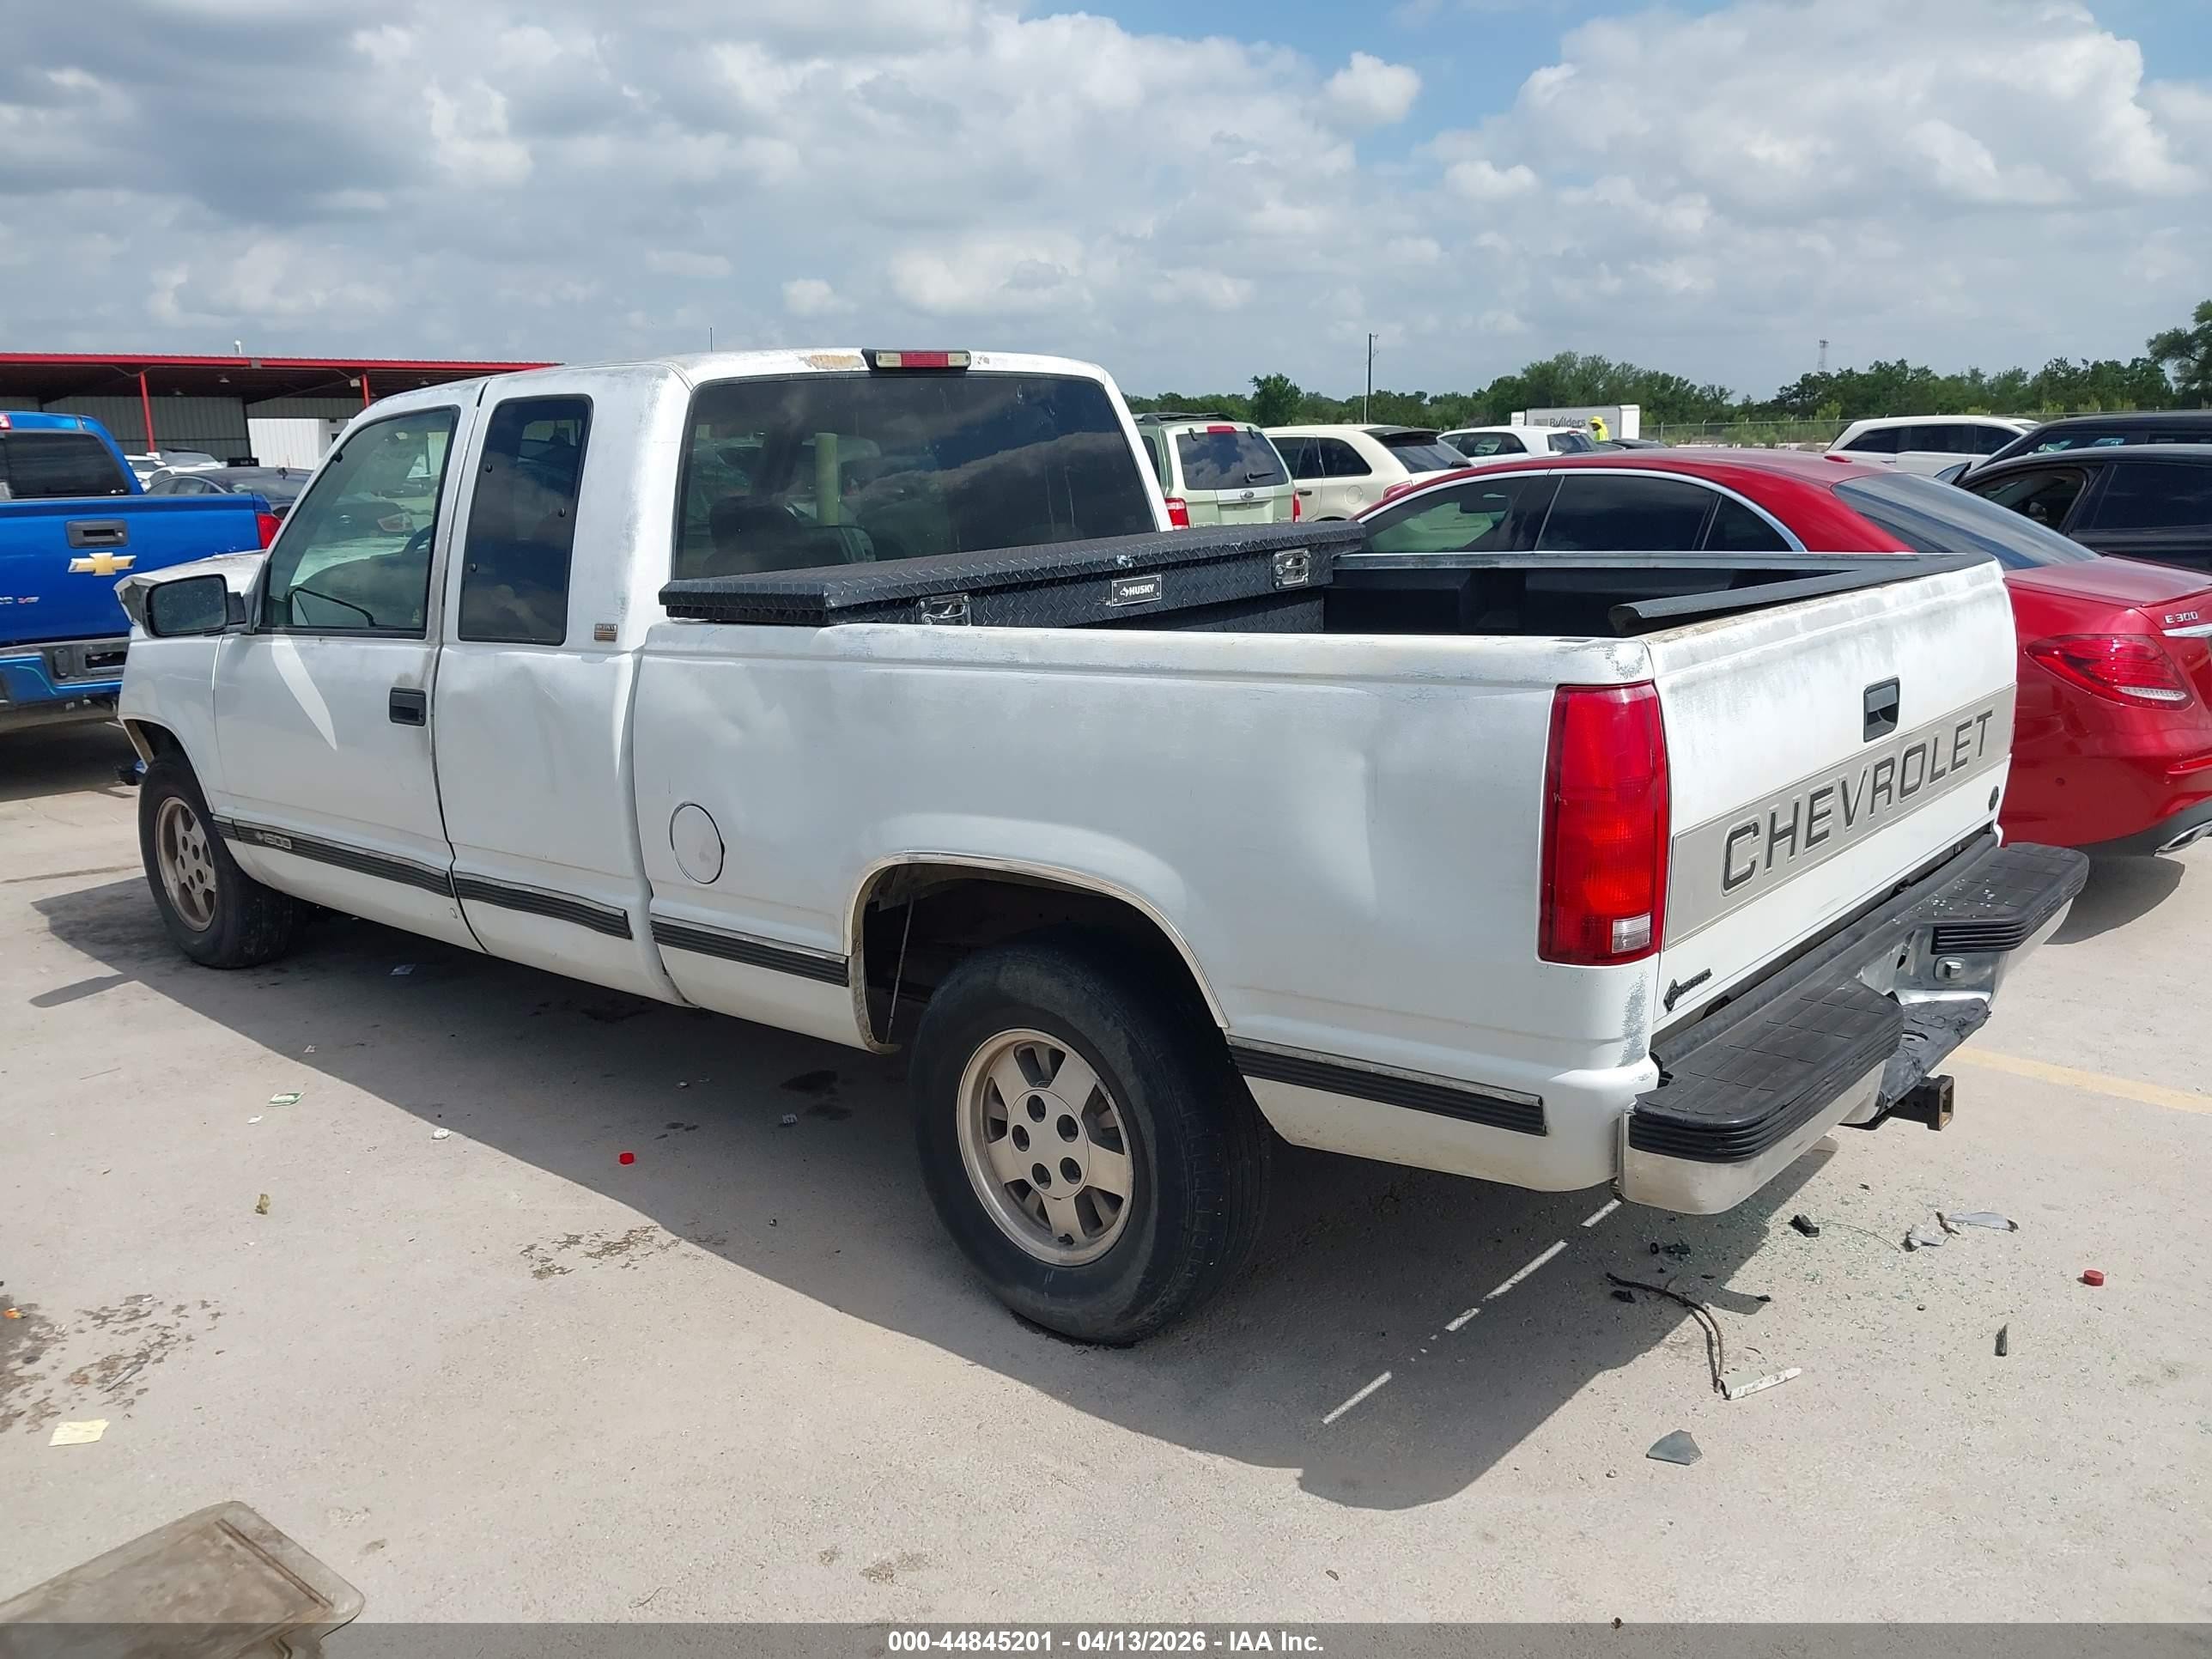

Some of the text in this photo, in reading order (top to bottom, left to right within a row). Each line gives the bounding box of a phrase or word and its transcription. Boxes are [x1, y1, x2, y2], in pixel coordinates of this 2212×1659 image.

[1549, 416, 1586, 428] Builders
[1129, 584, 1155, 595] HUSKY
[2165, 611, 2198, 623] E 300
[1720, 706, 1994, 895] CHEVROLET
